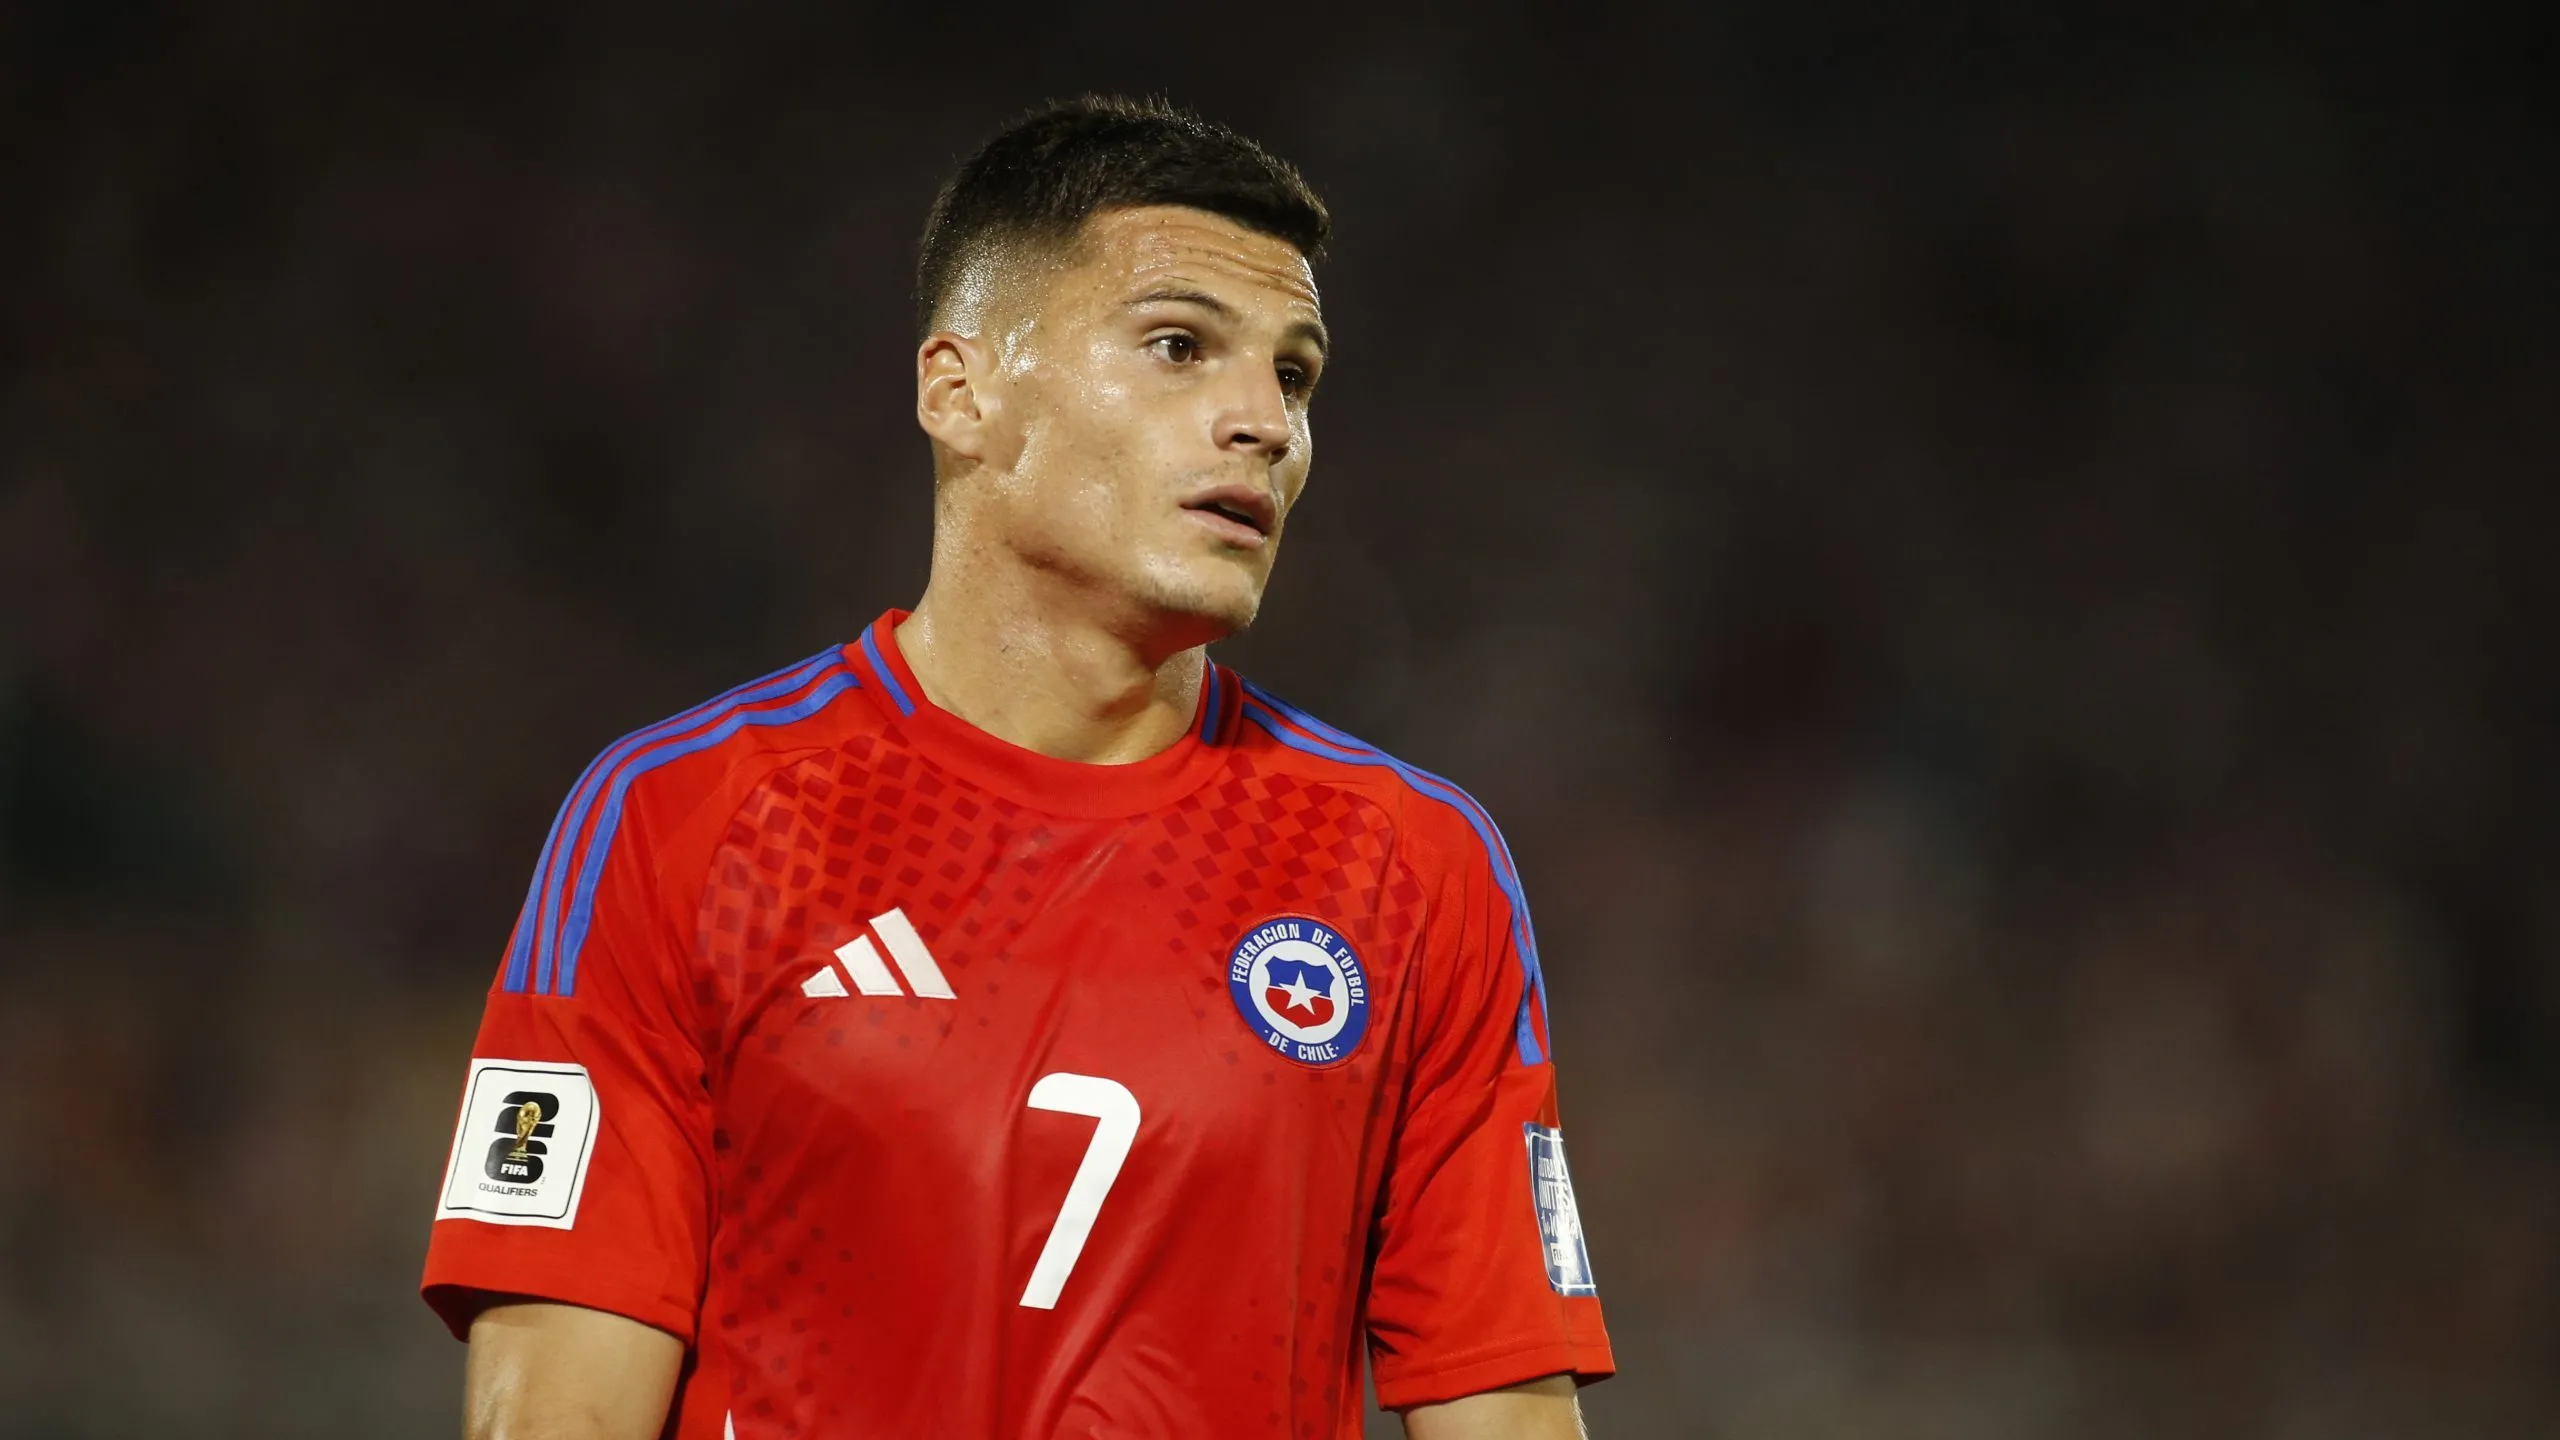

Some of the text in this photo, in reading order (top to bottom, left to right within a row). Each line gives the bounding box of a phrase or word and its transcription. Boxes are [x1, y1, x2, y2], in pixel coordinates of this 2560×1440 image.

[1232, 923, 1364, 1006] FEDERACION DE FUTBOL
[1268, 1033, 1337, 1061] DE CHILE
[500, 1164, 528, 1176] FIFA
[478, 1182, 537, 1196] QUALIFIERS
[1019, 1074, 1141, 1309] 7
